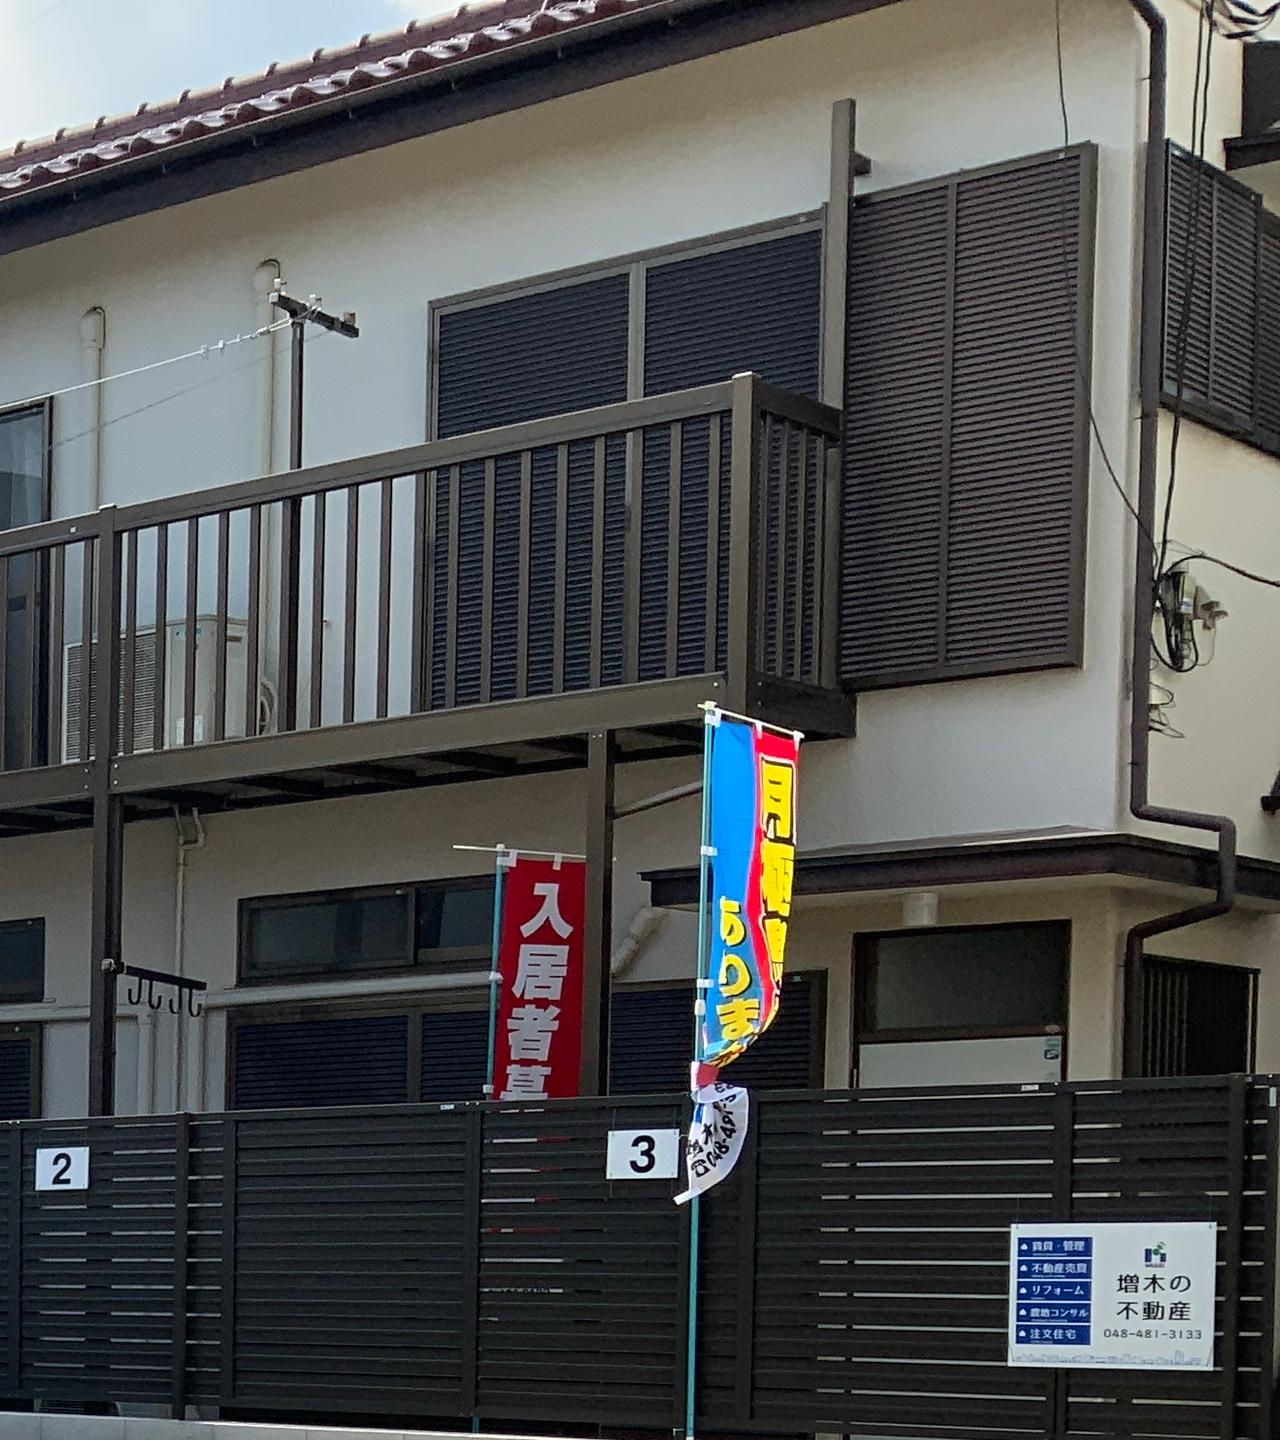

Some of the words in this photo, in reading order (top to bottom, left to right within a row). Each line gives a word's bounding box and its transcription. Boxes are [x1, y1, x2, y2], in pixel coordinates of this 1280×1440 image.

[500, 882, 574, 1101] 入居者募
[629, 1134, 656, 1174] 3
[51, 1152, 72, 1185] 2
[1032, 1285, 1085, 1296] リフォーム
[1116, 1273, 1191, 1294] 増木の
[1116, 1301, 1191, 1321] 不動産
[1029, 1328, 1077, 1340] 注文住宅
[1103, 1328, 1202, 1340] 048-481-3133
